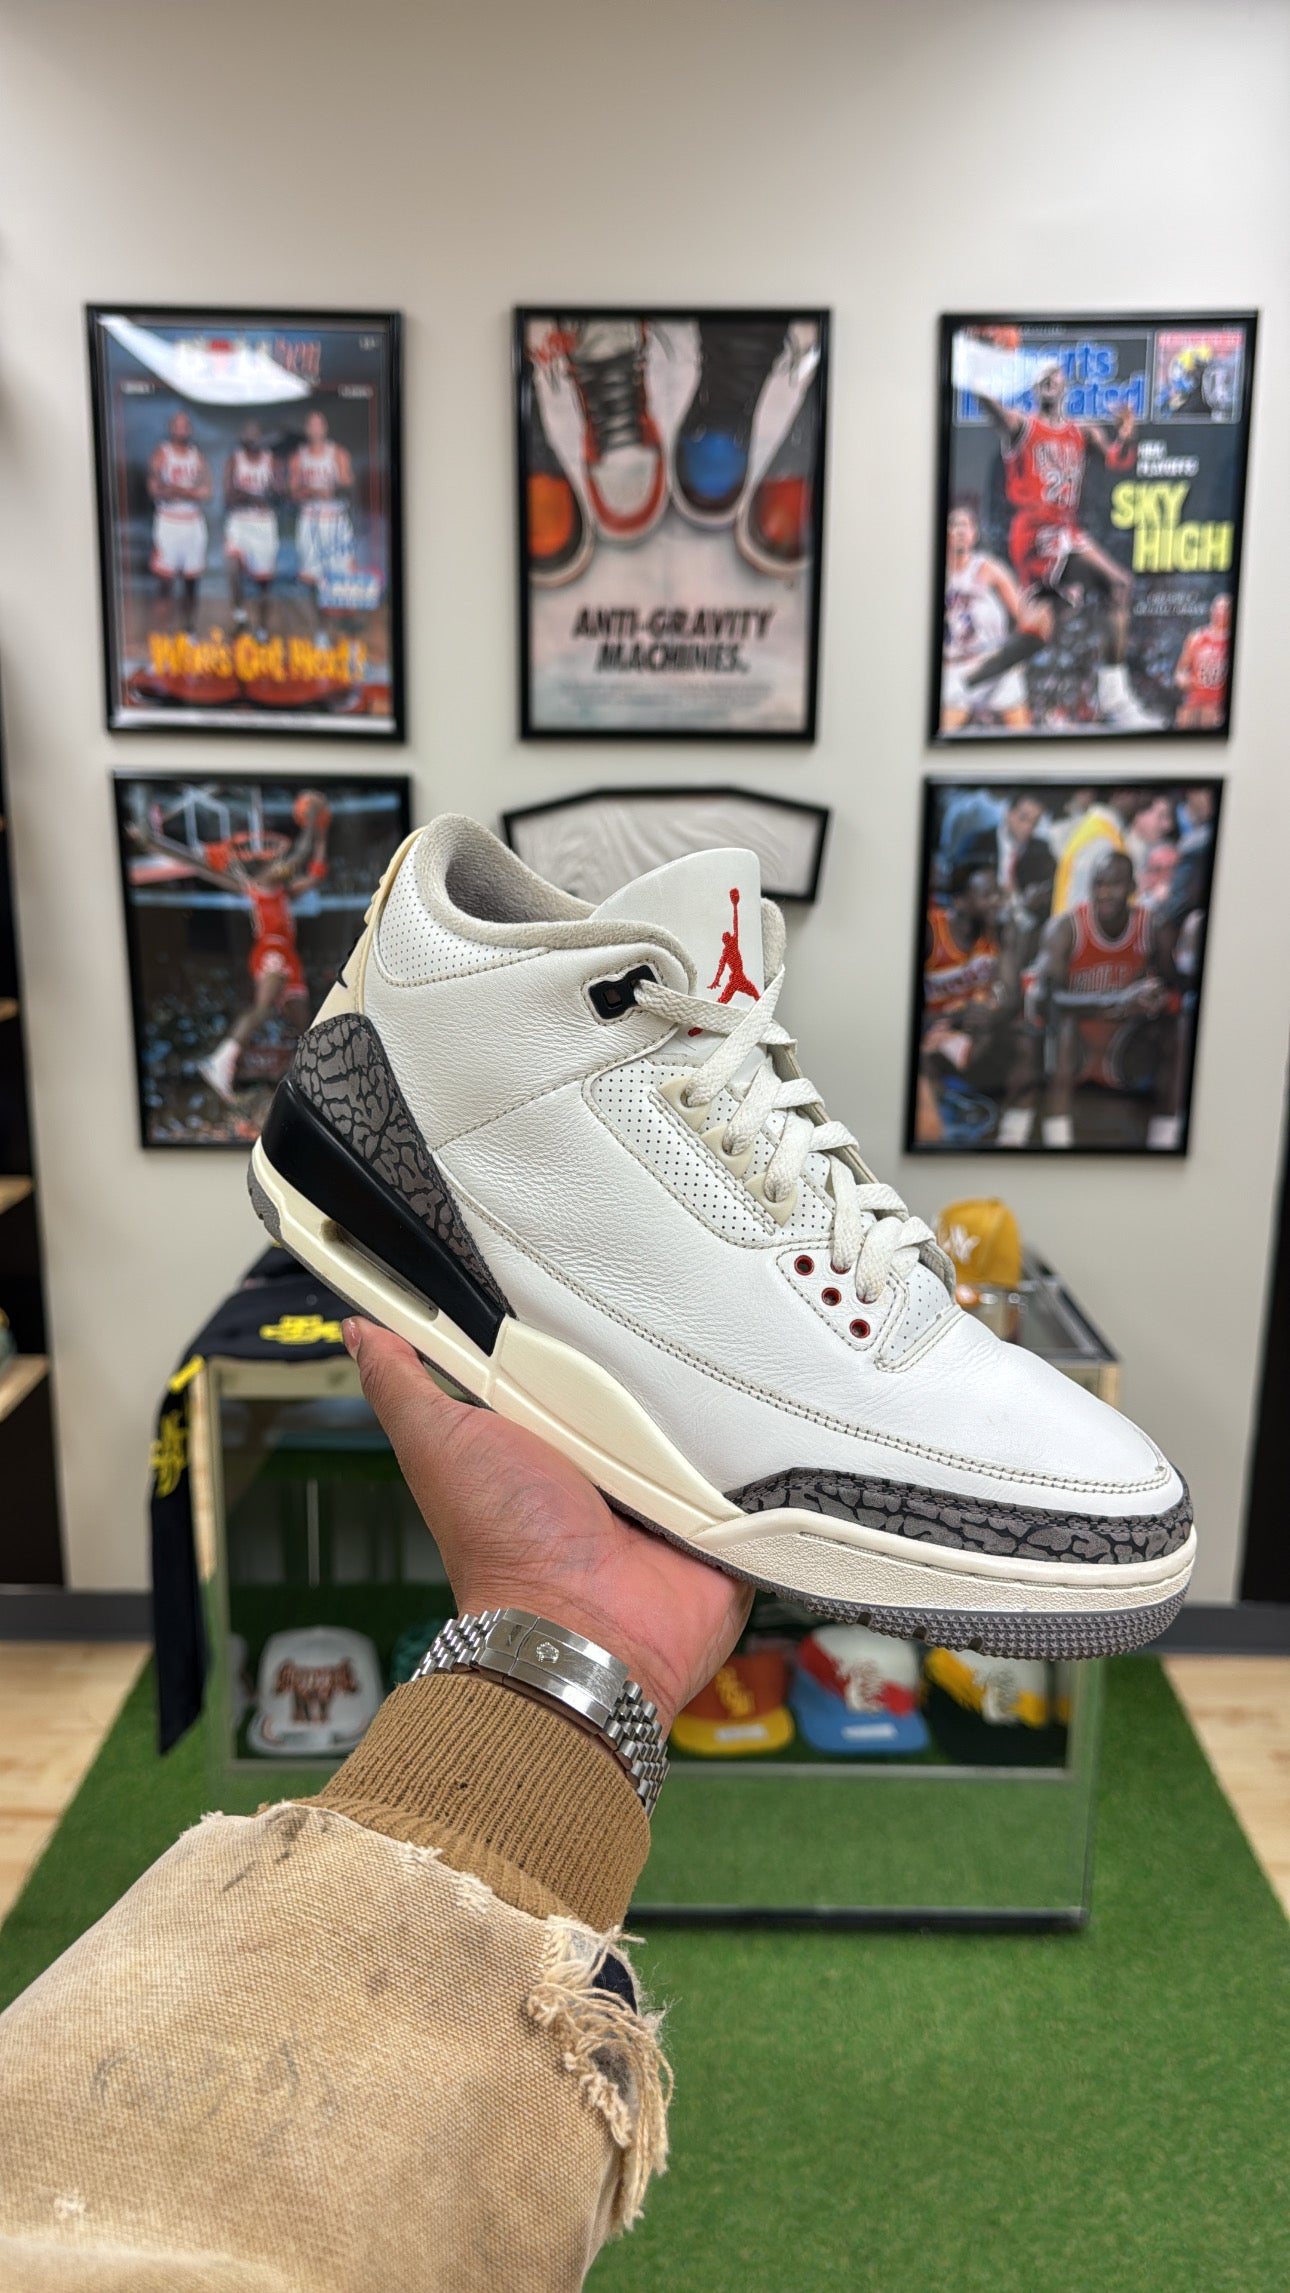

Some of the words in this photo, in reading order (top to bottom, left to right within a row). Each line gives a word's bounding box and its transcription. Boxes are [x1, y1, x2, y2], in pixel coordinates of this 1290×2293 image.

[1111, 480, 1190, 530] SKY
[1132, 521, 1235, 573] HIGH
[573, 605, 776, 639] ANTI-GRAVITY
[596, 641, 750, 674] MACHINES.
